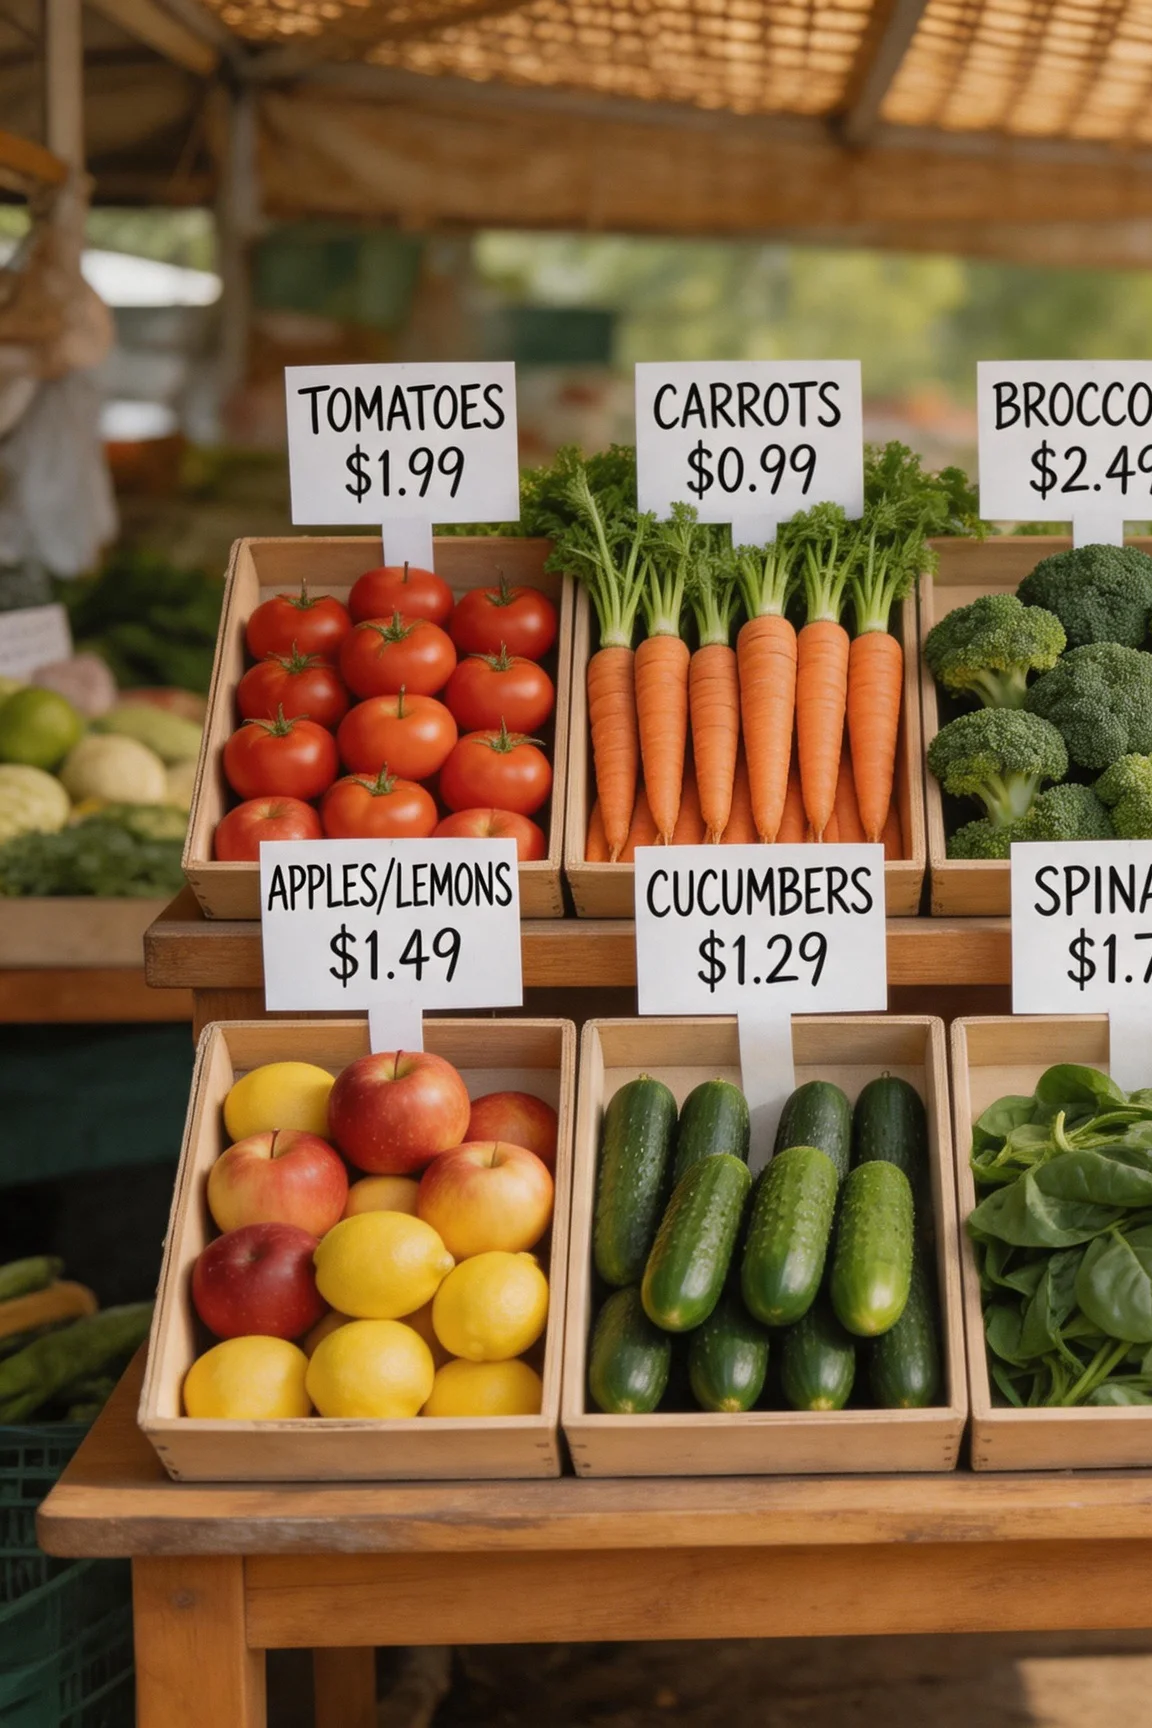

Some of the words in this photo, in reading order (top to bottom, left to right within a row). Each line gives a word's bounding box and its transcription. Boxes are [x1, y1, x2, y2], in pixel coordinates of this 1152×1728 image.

[297, 384, 505, 434] TOMATOES
[653, 380, 841, 430] CARROTS
[345, 443, 465, 504] $1.99
[686, 439, 817, 501] $0.99
[267, 857, 513, 916] APPLES/LEMONS
[646, 866, 873, 918] CUCUMBERS
[329, 923, 461, 989] $1.49
[697, 929, 828, 993] $1.29
